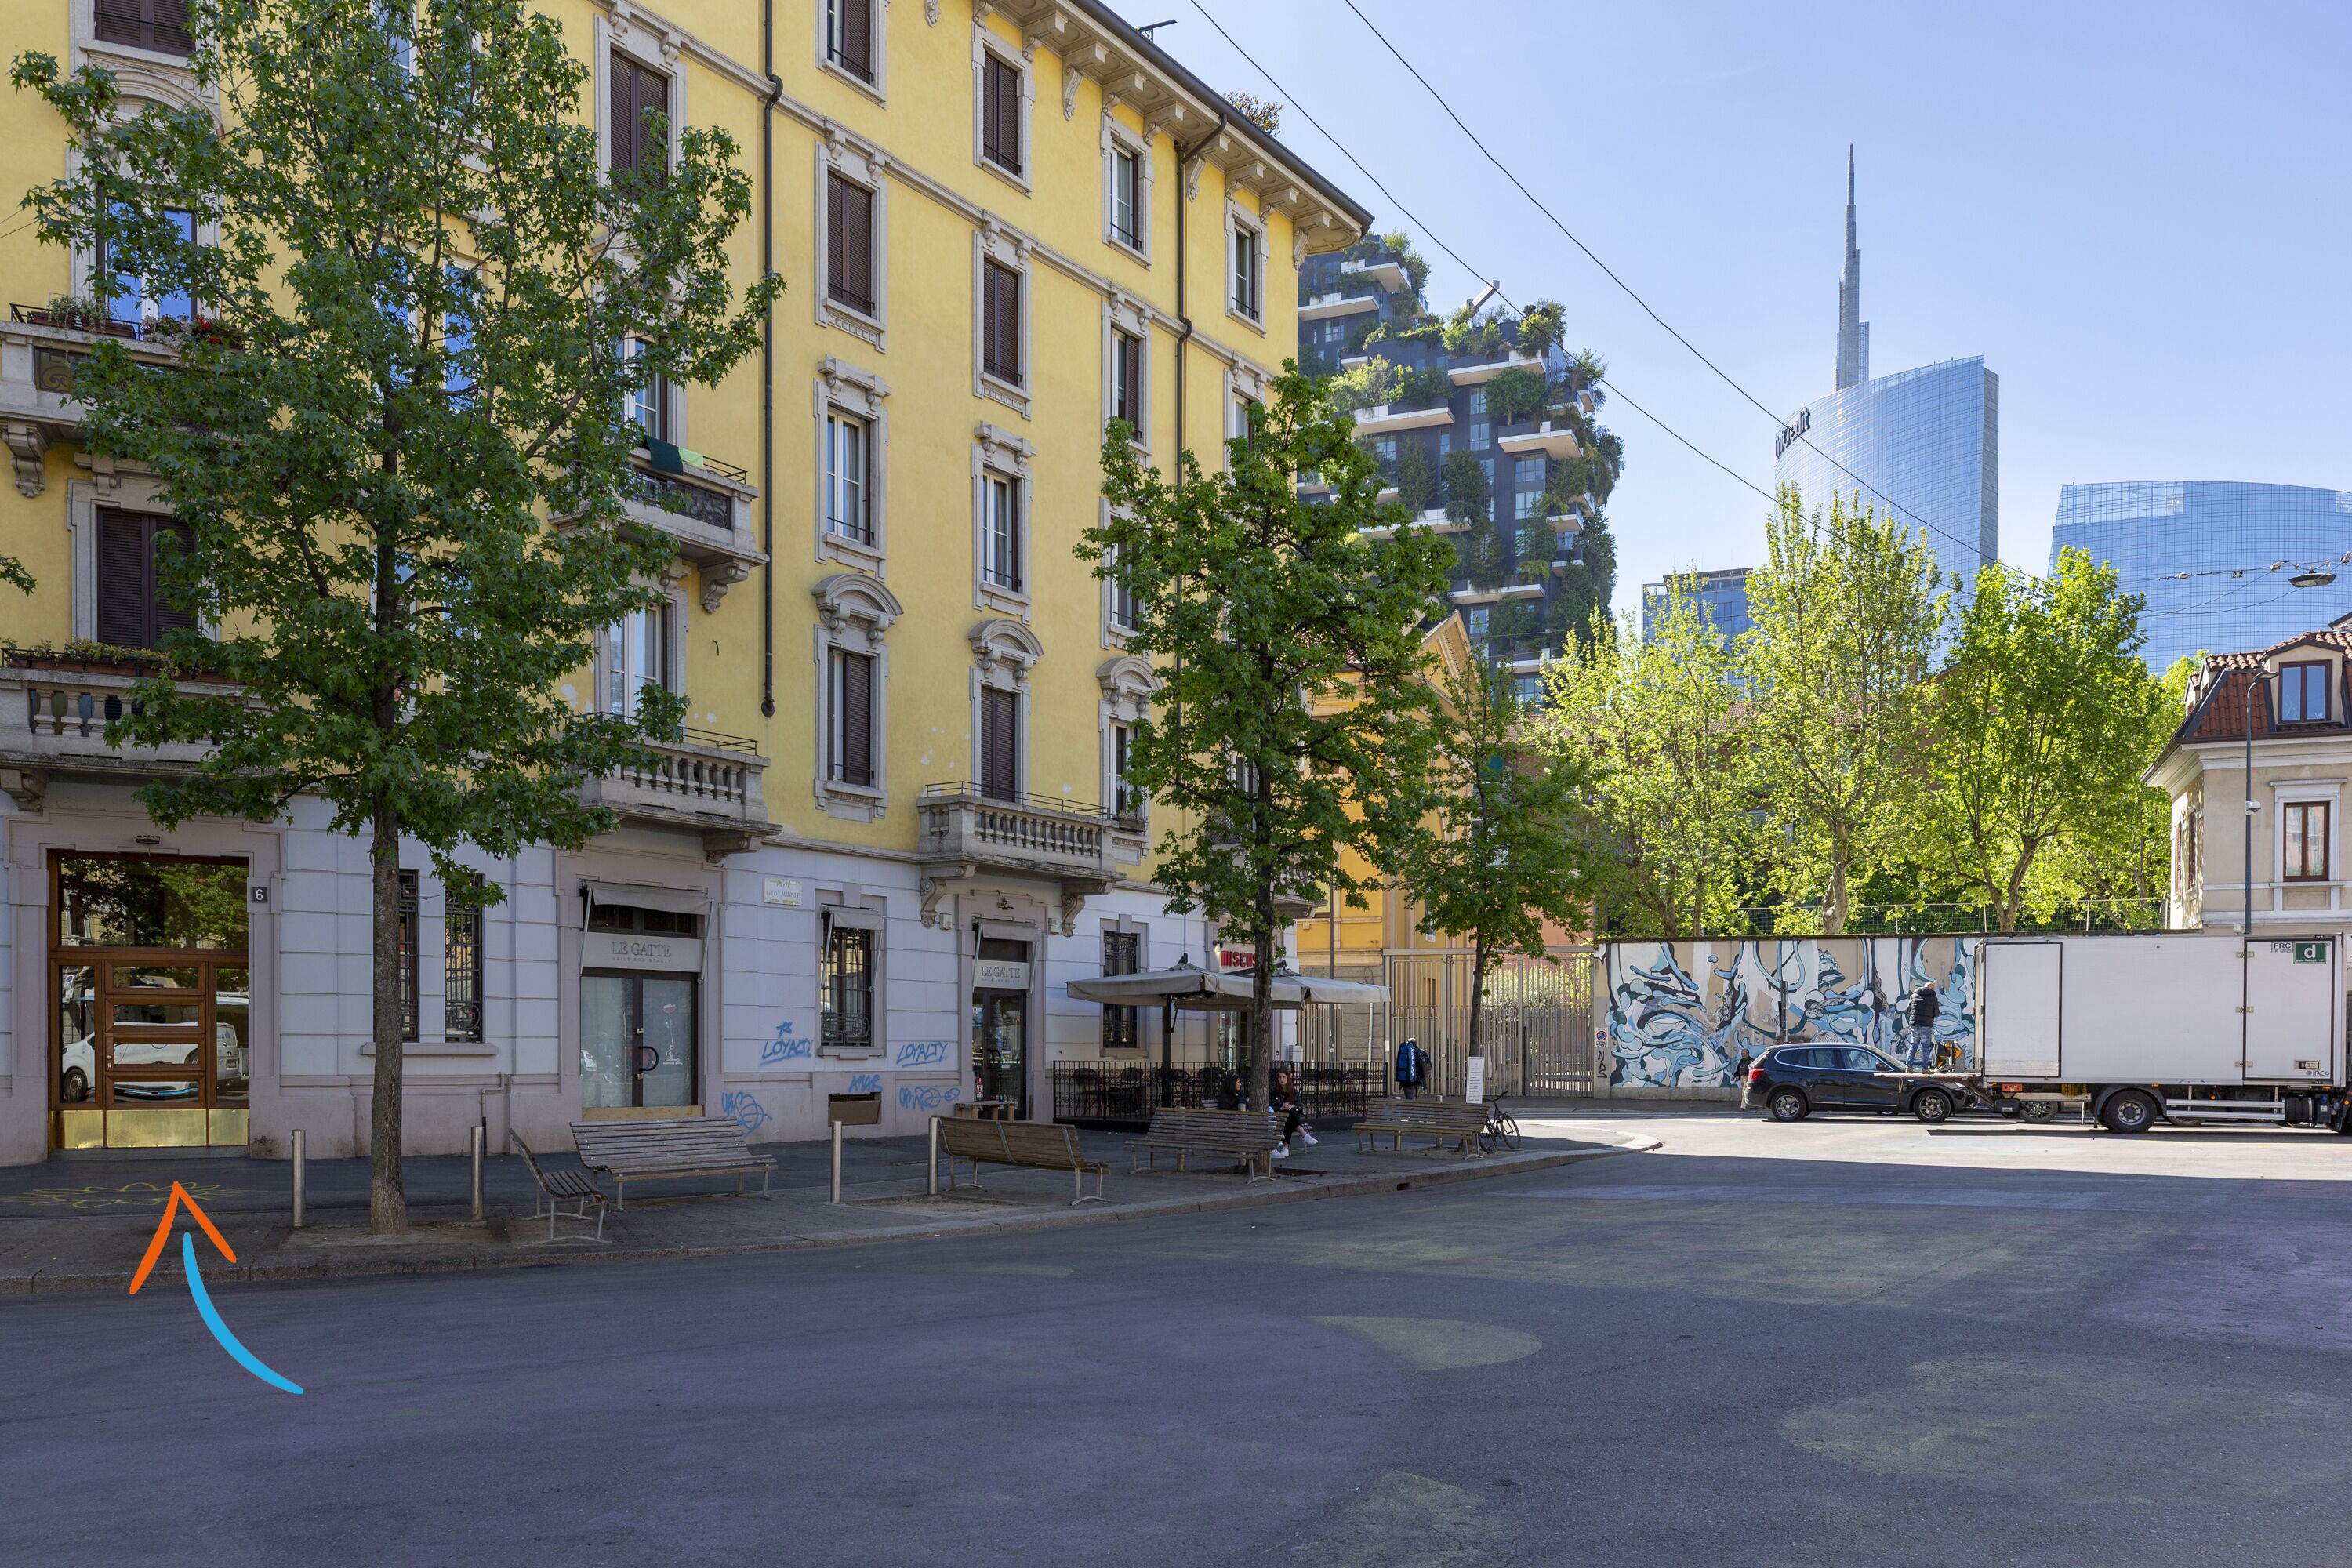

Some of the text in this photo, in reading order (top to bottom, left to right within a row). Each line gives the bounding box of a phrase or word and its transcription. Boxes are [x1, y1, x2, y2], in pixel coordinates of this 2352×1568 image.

[256, 889, 263, 901] 6
[612, 942, 672, 957] LE GATTE
[2304, 944, 2316, 958] d
[982, 966, 1021, 978] LE GATTE
[896, 1042, 948, 1065] LOYALTY
